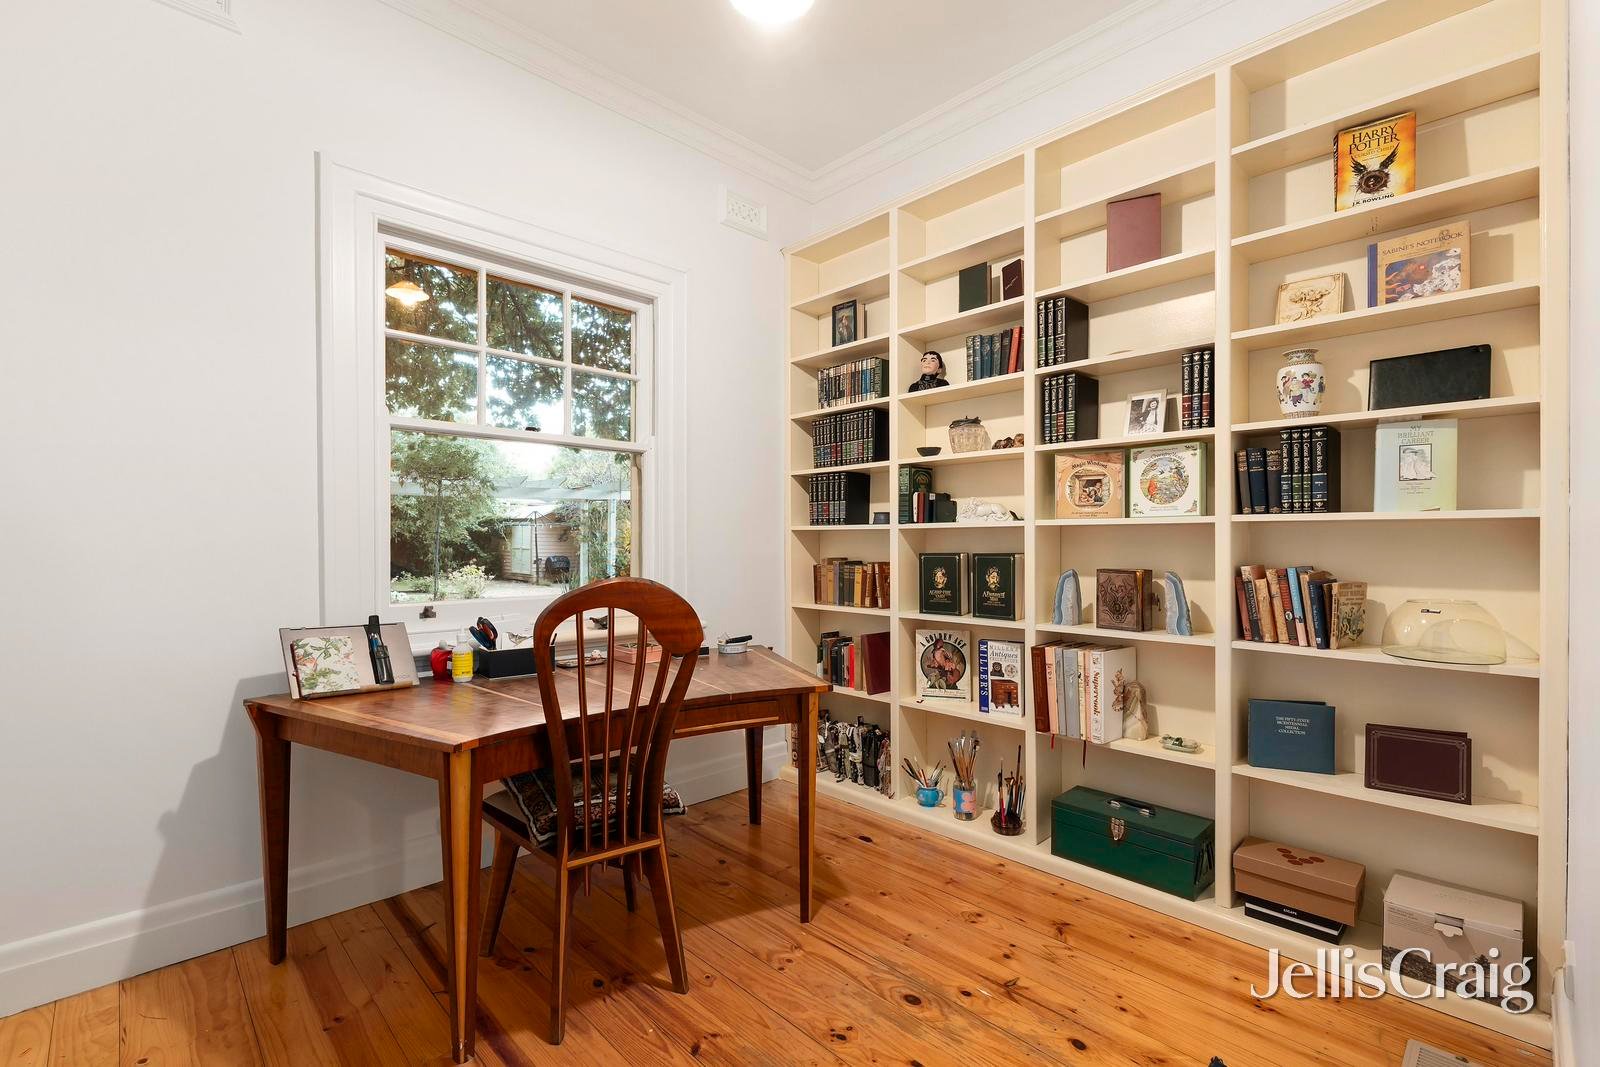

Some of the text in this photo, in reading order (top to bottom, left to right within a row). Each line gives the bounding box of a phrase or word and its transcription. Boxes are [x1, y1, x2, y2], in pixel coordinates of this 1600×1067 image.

[1352, 122, 1399, 144] HARRY
[1349, 133, 1401, 154] POTTER
[1362, 194, 1395, 204] ROWLING
[1397, 430, 1434, 439] BRILLIANT
[925, 632, 952, 645] GOLDEN
[954, 637, 967, 649] AGE
[989, 651, 1018, 660] Antiques
[979, 644, 988, 696] MILLER'S
